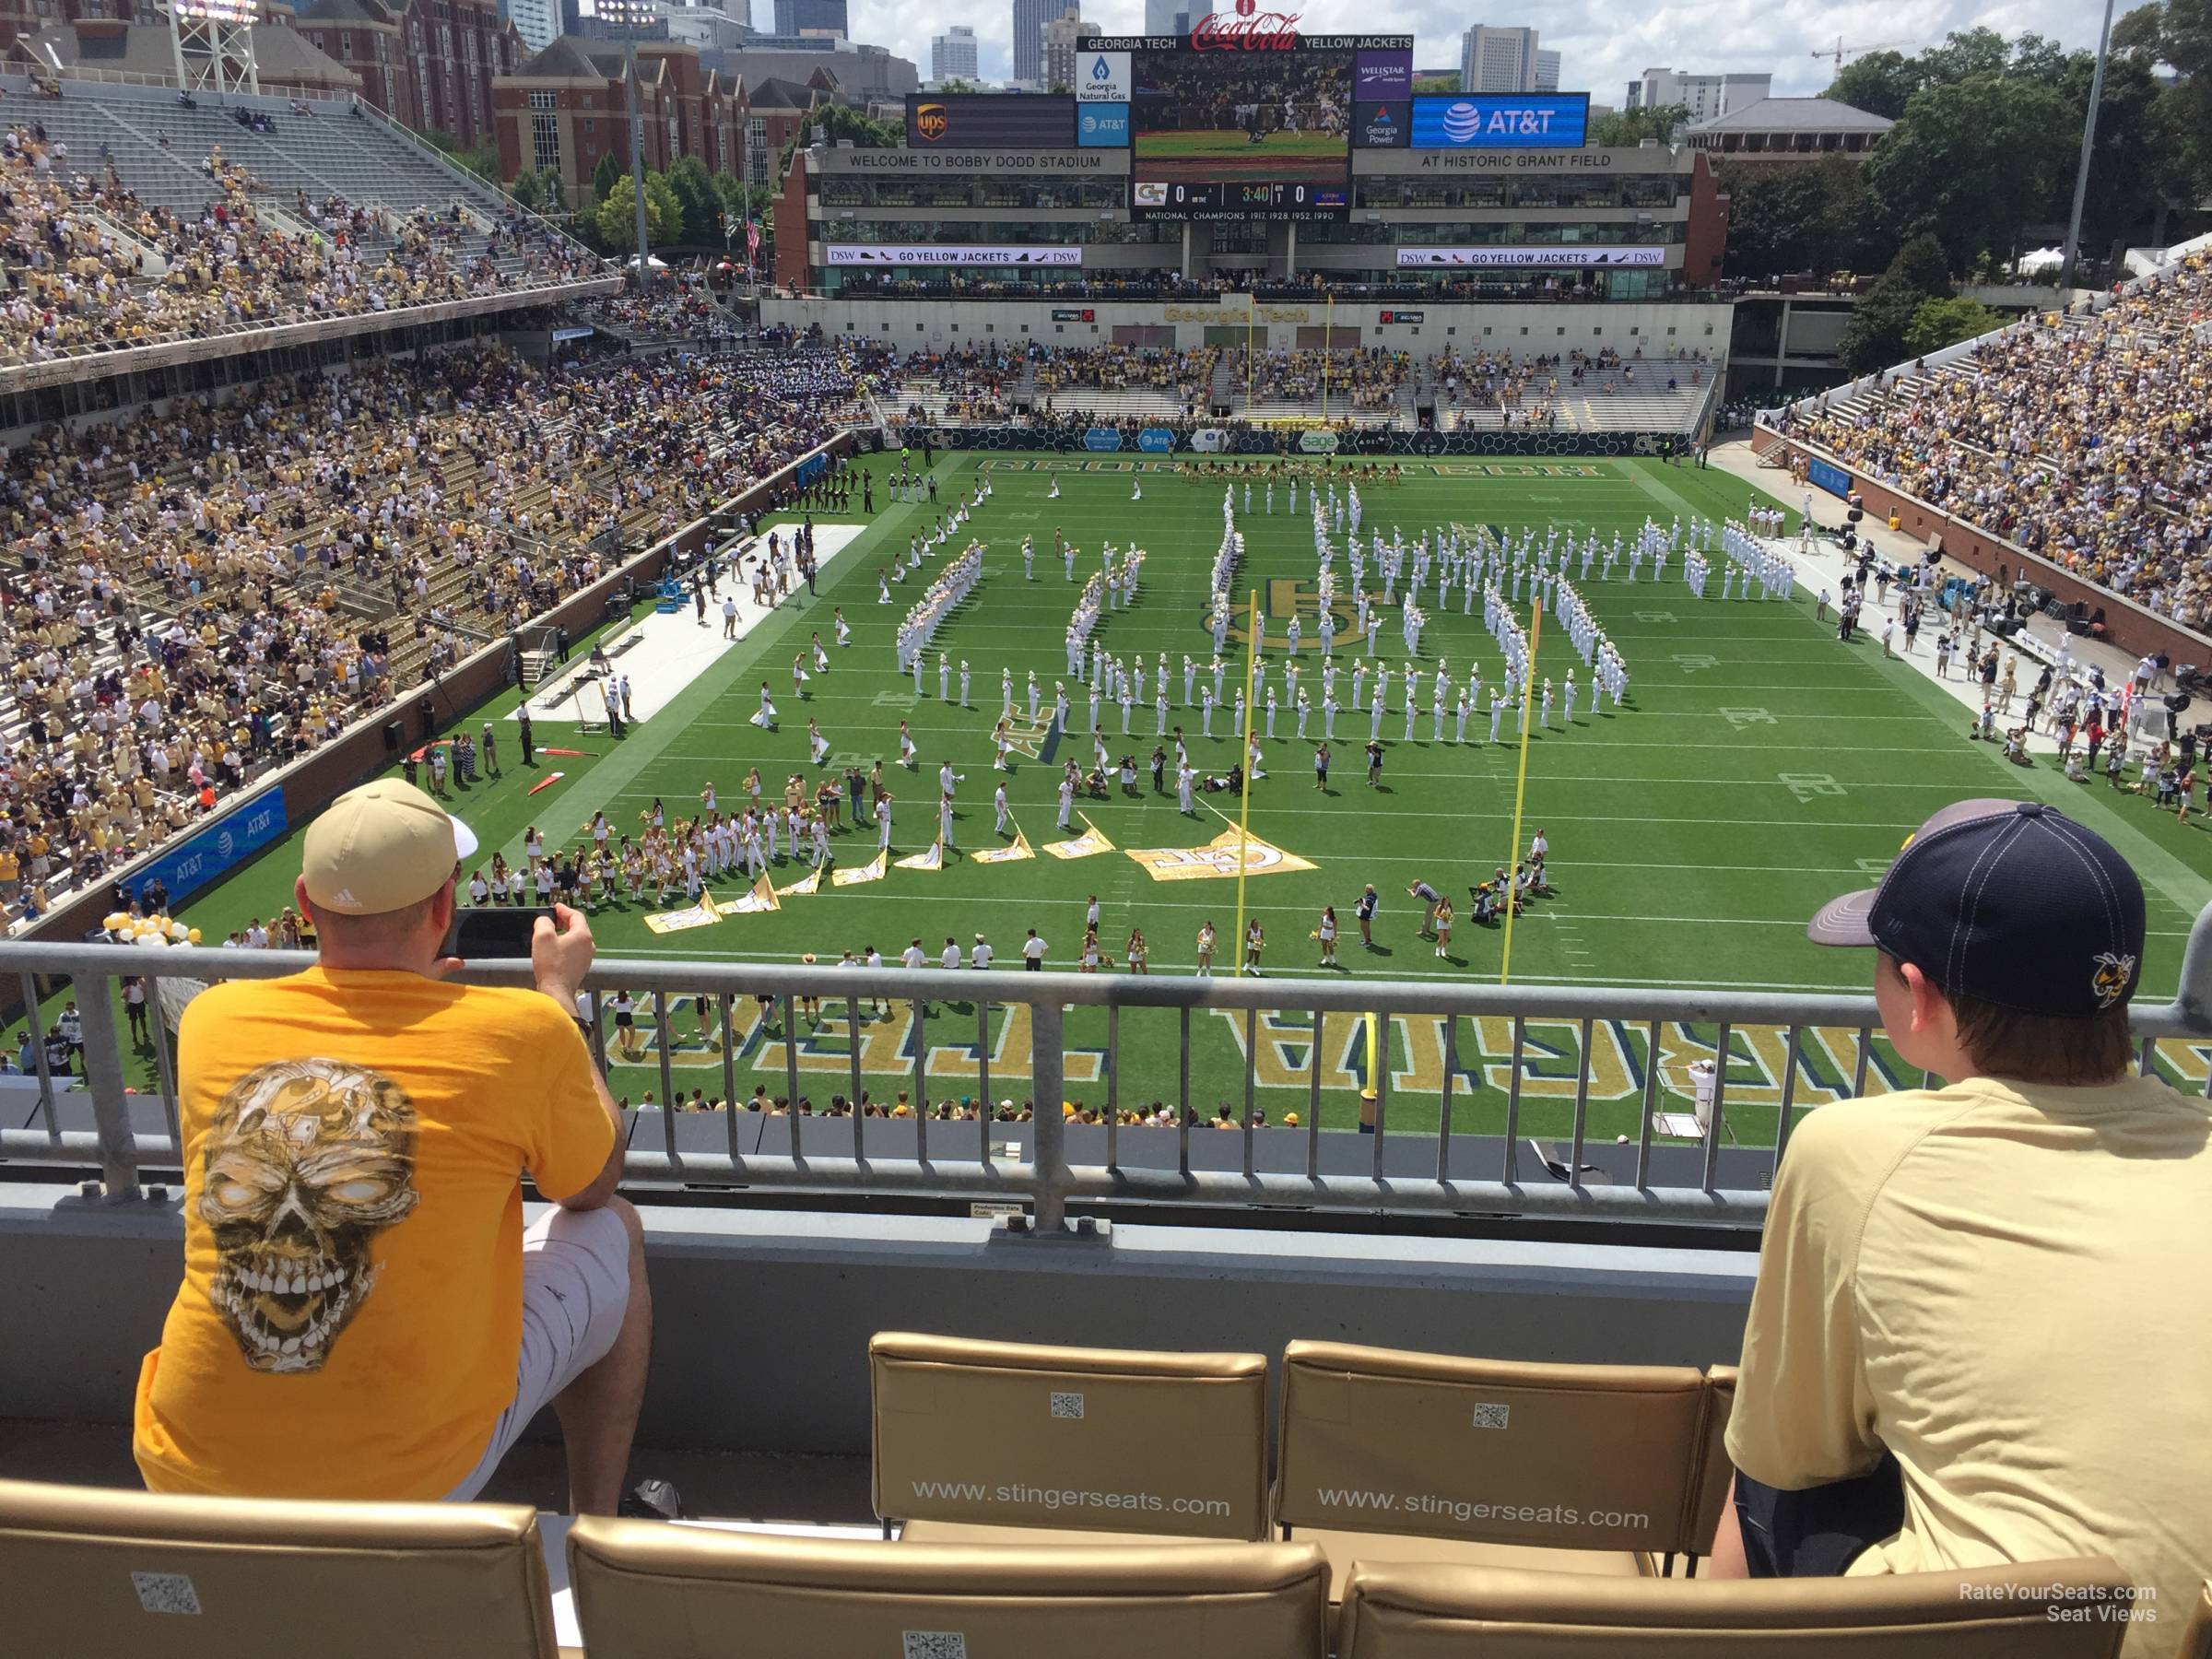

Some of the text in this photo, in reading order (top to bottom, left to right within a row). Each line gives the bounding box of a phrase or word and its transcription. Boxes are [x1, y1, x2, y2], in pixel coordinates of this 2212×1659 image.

[1088, 38, 1177, 49] GEORGIA TECH
[1304, 38, 1412, 48] YELLOW JACKETS
[1086, 82, 1117, 93] Georgia
[1079, 92, 1110, 100] Natural
[920, 114, 945, 135] ups
[1098, 120, 1126, 130] AT&T
[1486, 110, 1555, 134] AT&T
[1366, 125, 1398, 136] Georgia
[1369, 135, 1394, 144] Power
[850, 155, 1101, 168] WELCOME TO BOBBY DODD STADIUM
[1421, 155, 1611, 168] AT HISTORIC GRANT FIELD
[1175, 185, 1185, 203] 0
[1242, 186, 1270, 202] 3:40
[1295, 185, 1305, 203] 0
[1145, 212, 1188, 220] NATIONAL
[1193, 212, 1245, 220] CHAMPIONS
[1314, 212, 1335, 220] 1990
[831, 251, 855, 261] DSW
[899, 252, 1010, 263] GO YELLOW JACKETS
[1053, 253, 1078, 263] DSW
[1400, 253, 1427, 264] DSW
[1471, 253, 1588, 264] GO YELLOW JACKETS
[1633, 253, 1661, 263] DSW
[1164, 305, 1310, 325] Georgia Tech
[1303, 436, 1335, 450] sage
[246, 808, 271, 839] AT&T
[175, 851, 203, 884] AT&T
[911, 1480, 1230, 1517] www.stingerseats.com
[1317, 1488, 1650, 1529] www.stingerseats.com
